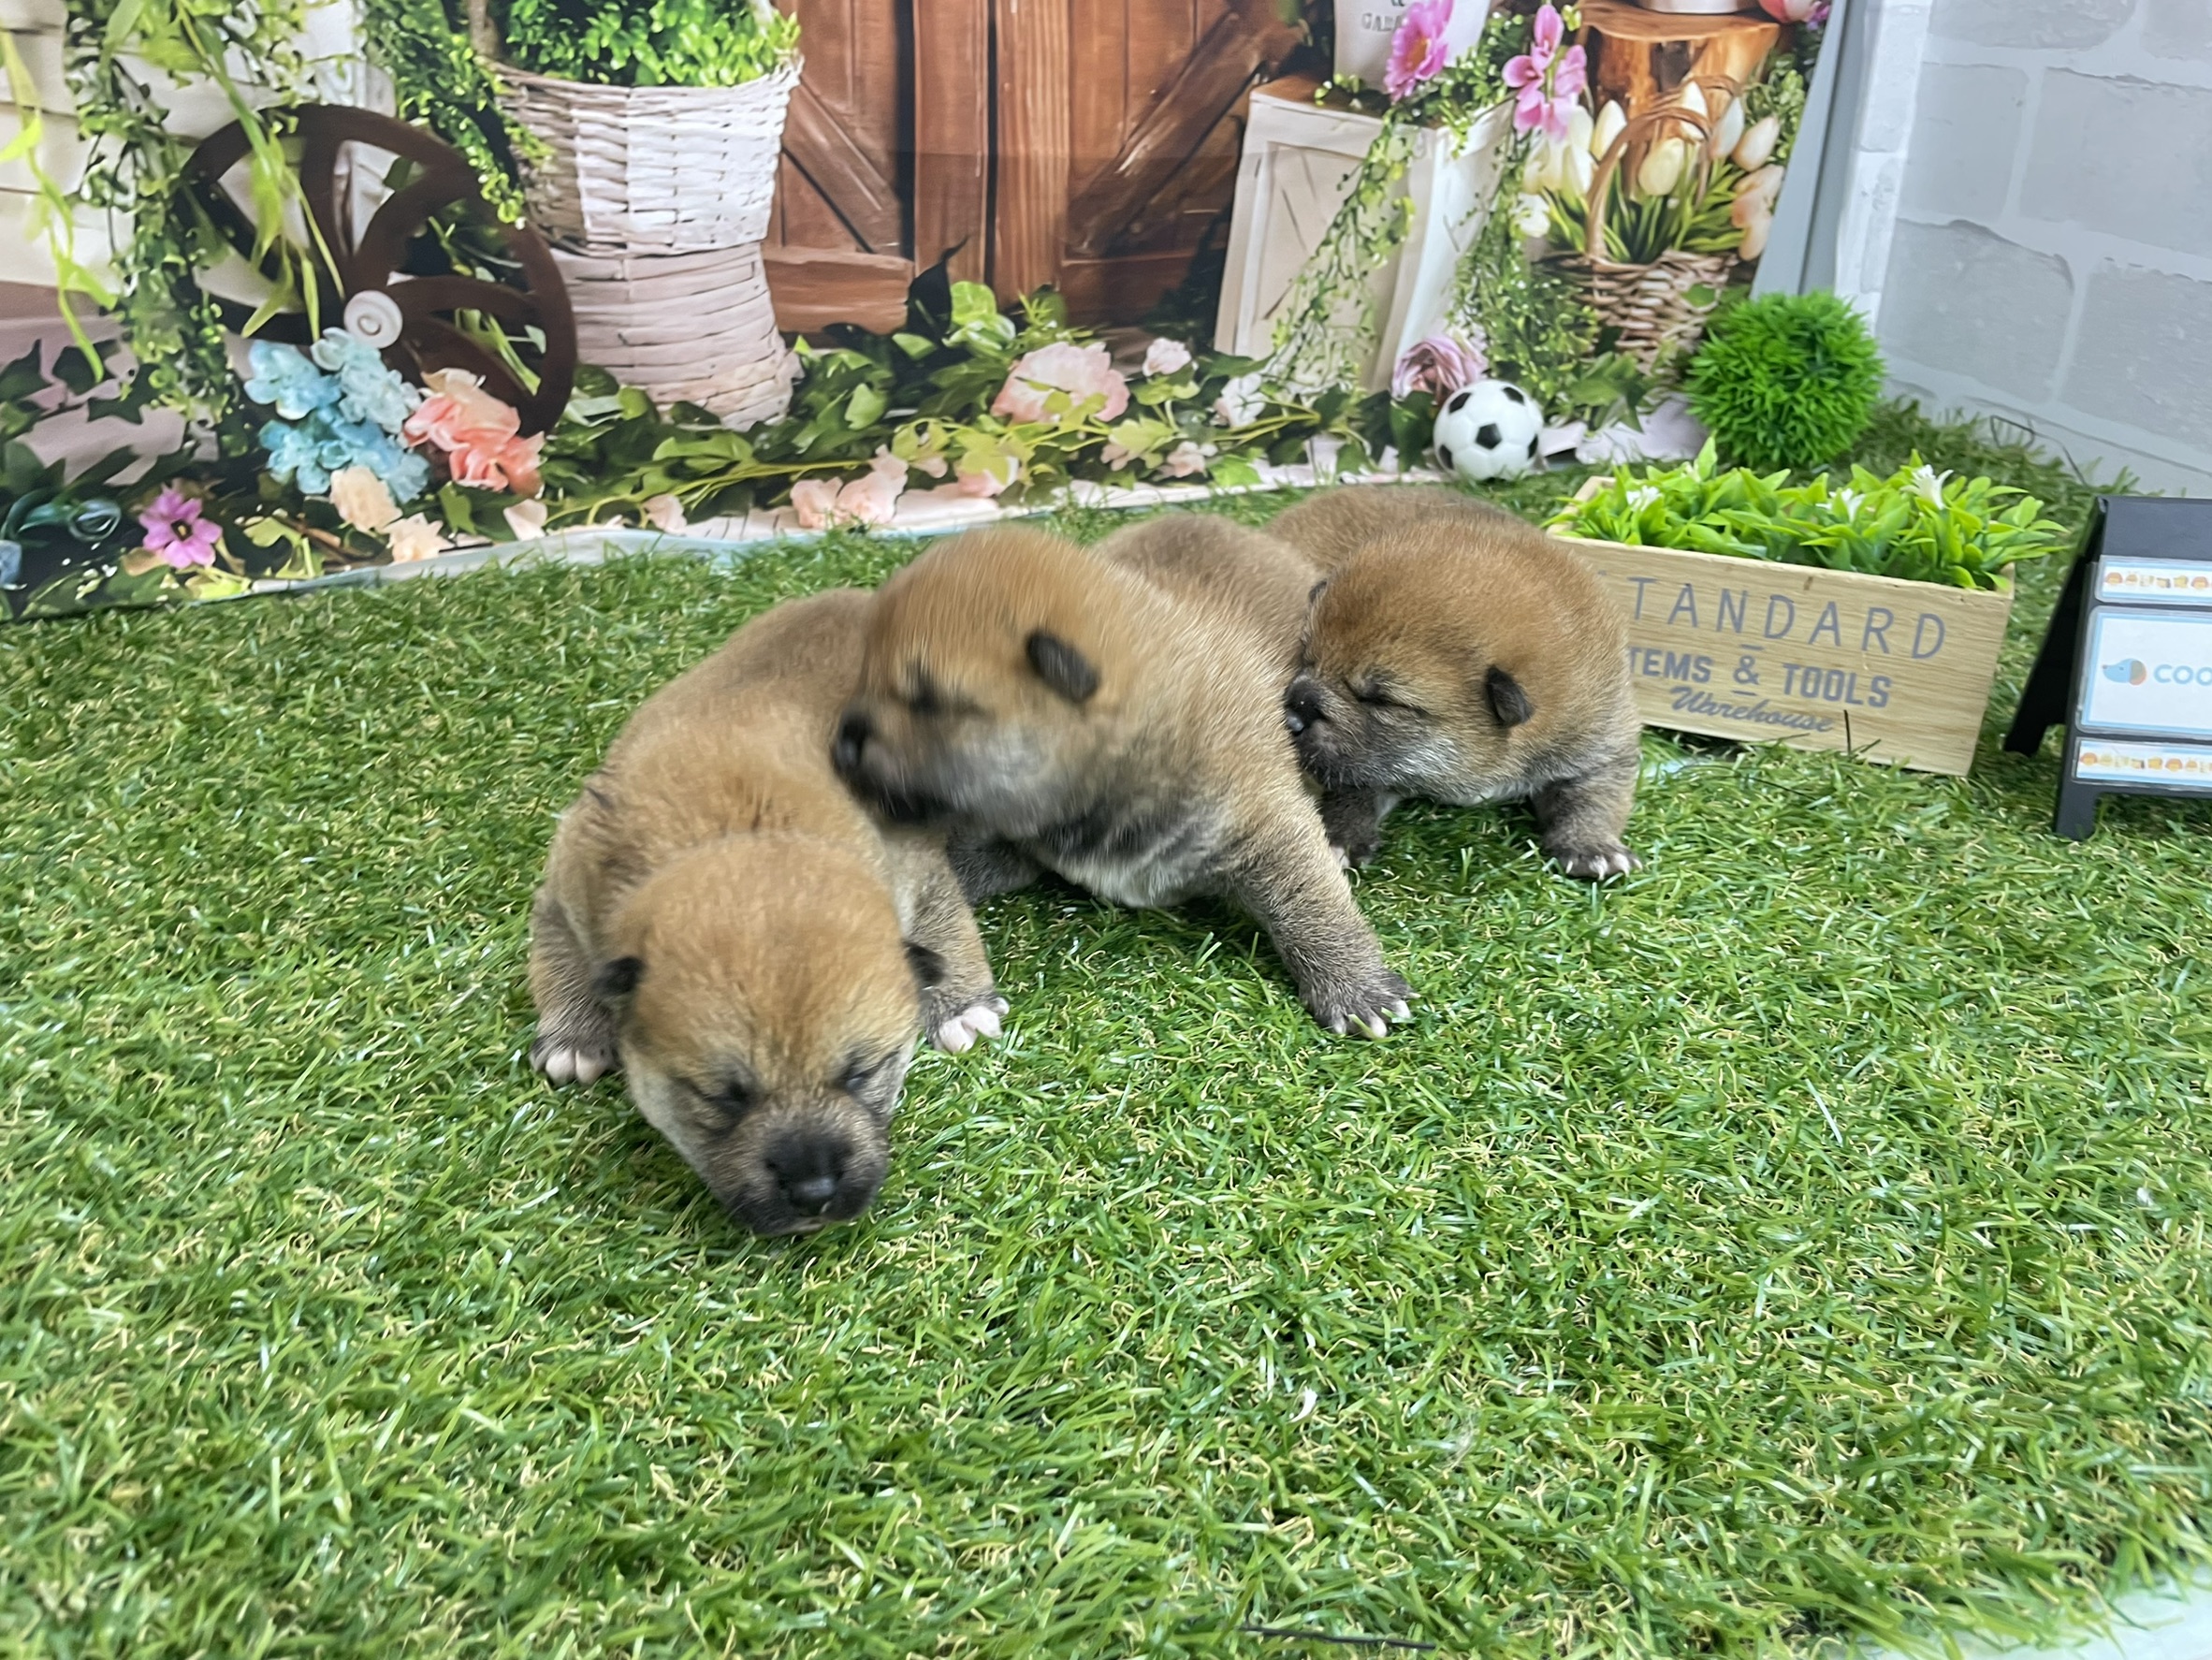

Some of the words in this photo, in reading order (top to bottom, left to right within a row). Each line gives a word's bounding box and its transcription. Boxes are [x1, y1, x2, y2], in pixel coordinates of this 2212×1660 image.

[1596, 570, 1945, 660] TANDARD
[1733, 655, 1760, 685] &
[1782, 662, 1893, 708] TOOLS
[1668, 685, 1835, 733] Warehouse
